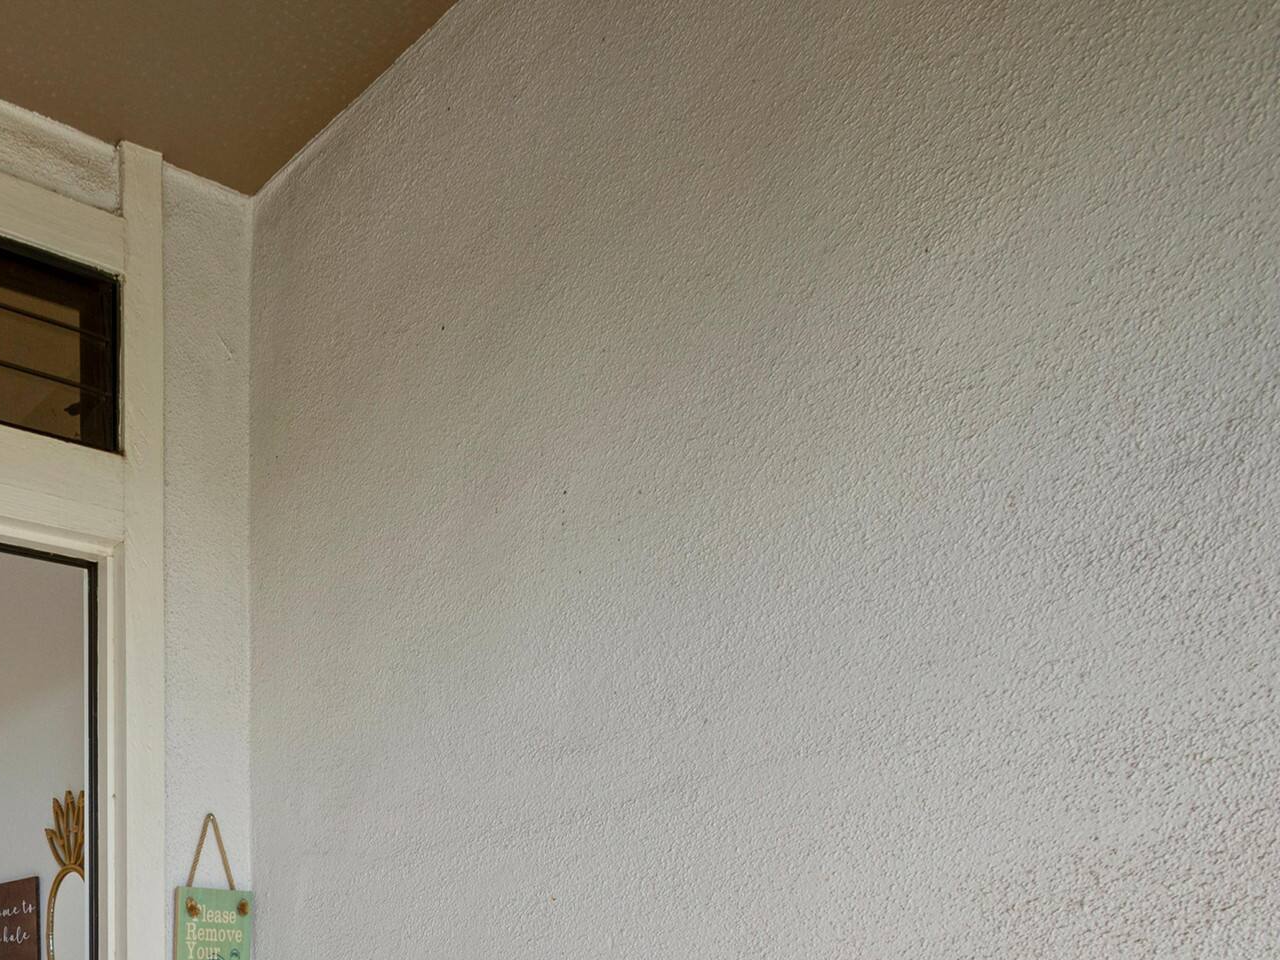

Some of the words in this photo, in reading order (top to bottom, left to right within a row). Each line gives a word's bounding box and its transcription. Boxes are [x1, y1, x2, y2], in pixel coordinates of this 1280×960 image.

[22, 899, 37, 914] to
[186, 922, 243, 943] Remove
[185, 941, 220, 960] Your
